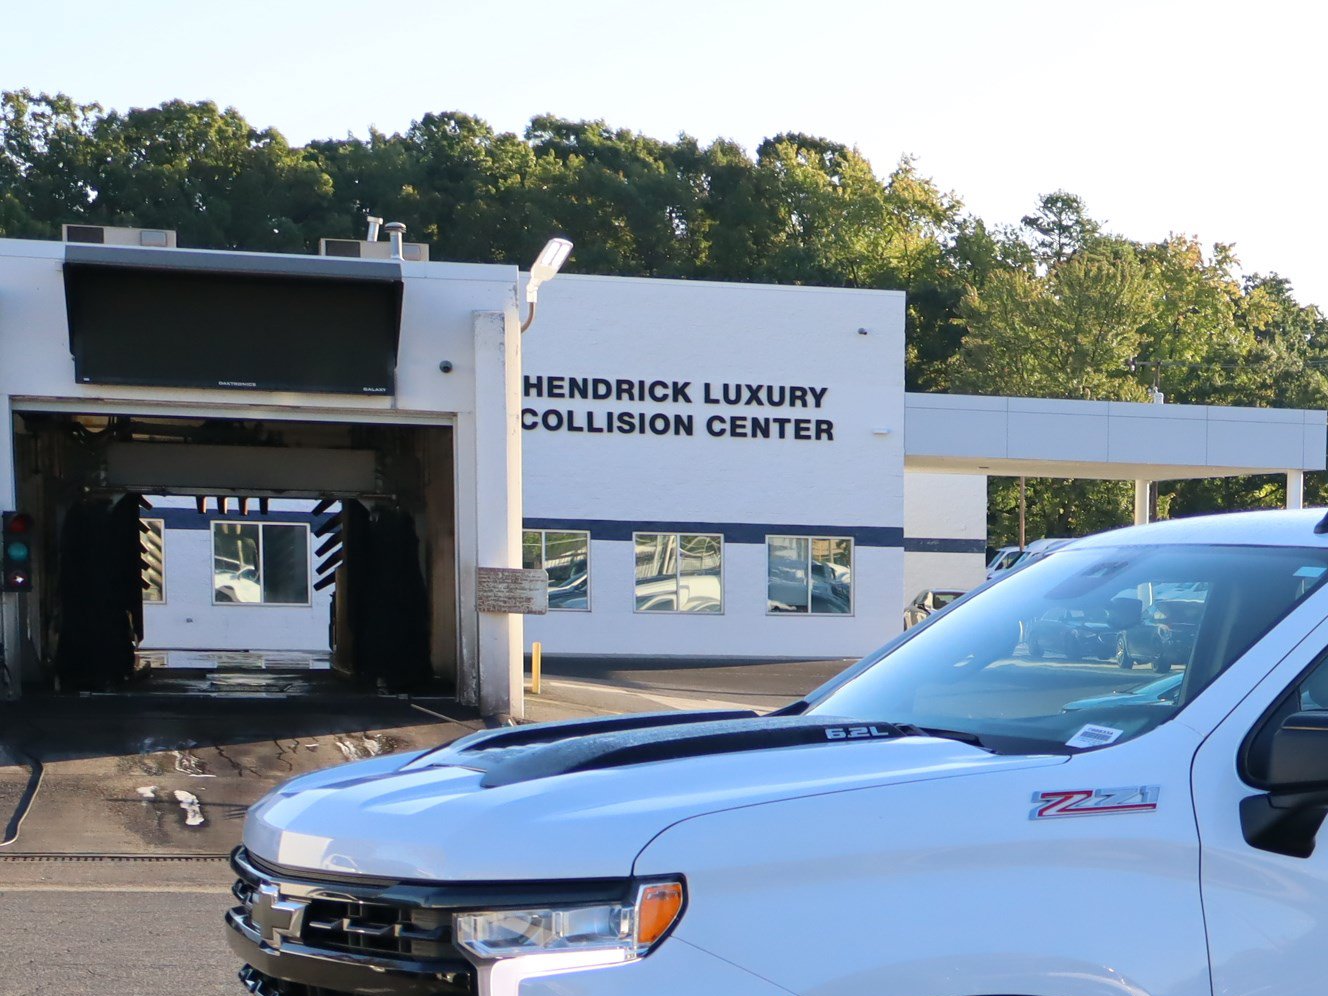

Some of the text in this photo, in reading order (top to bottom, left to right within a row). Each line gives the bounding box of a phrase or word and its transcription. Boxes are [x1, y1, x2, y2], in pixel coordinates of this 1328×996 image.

[523, 375, 828, 408] HENDRICK LUXURY
[521, 408, 834, 441] COLLISION CENTER
[1028, 785, 1160, 820] Z71
